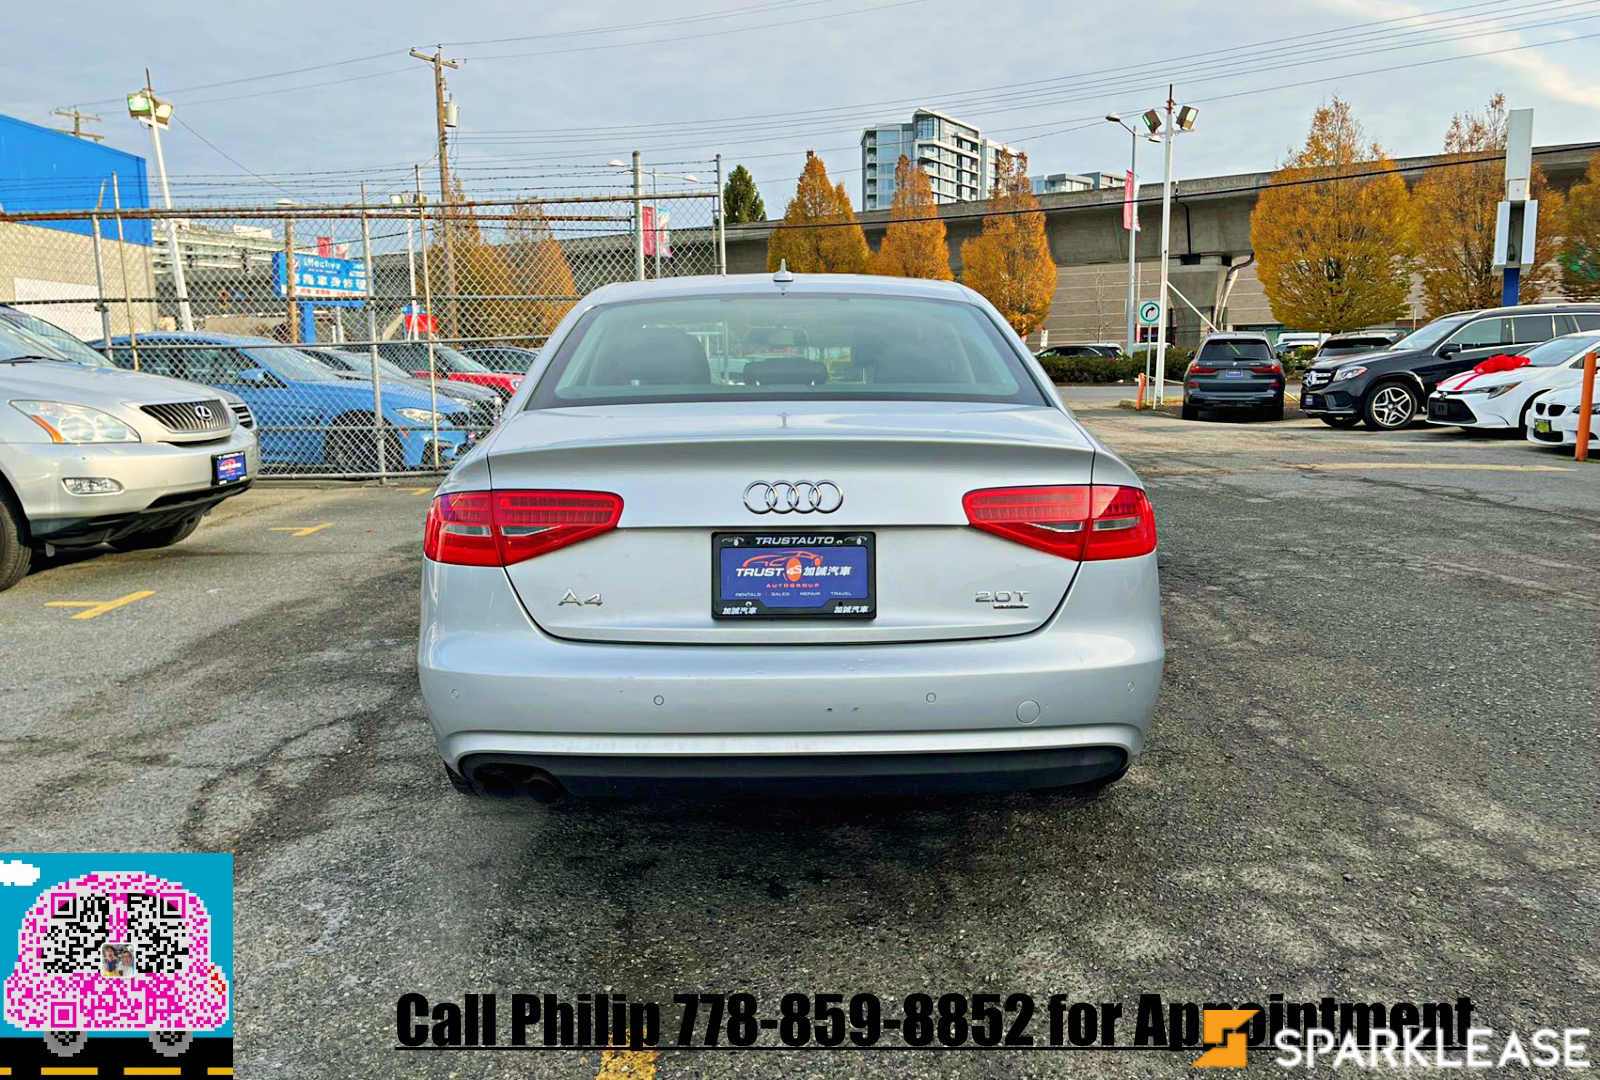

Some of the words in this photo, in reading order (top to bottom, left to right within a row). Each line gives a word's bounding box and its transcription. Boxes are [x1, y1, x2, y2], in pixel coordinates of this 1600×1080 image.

[755, 537, 834, 545] TRUSTAUTO
[736, 567, 785, 577] TRUST
[558, 588, 604, 607] A4
